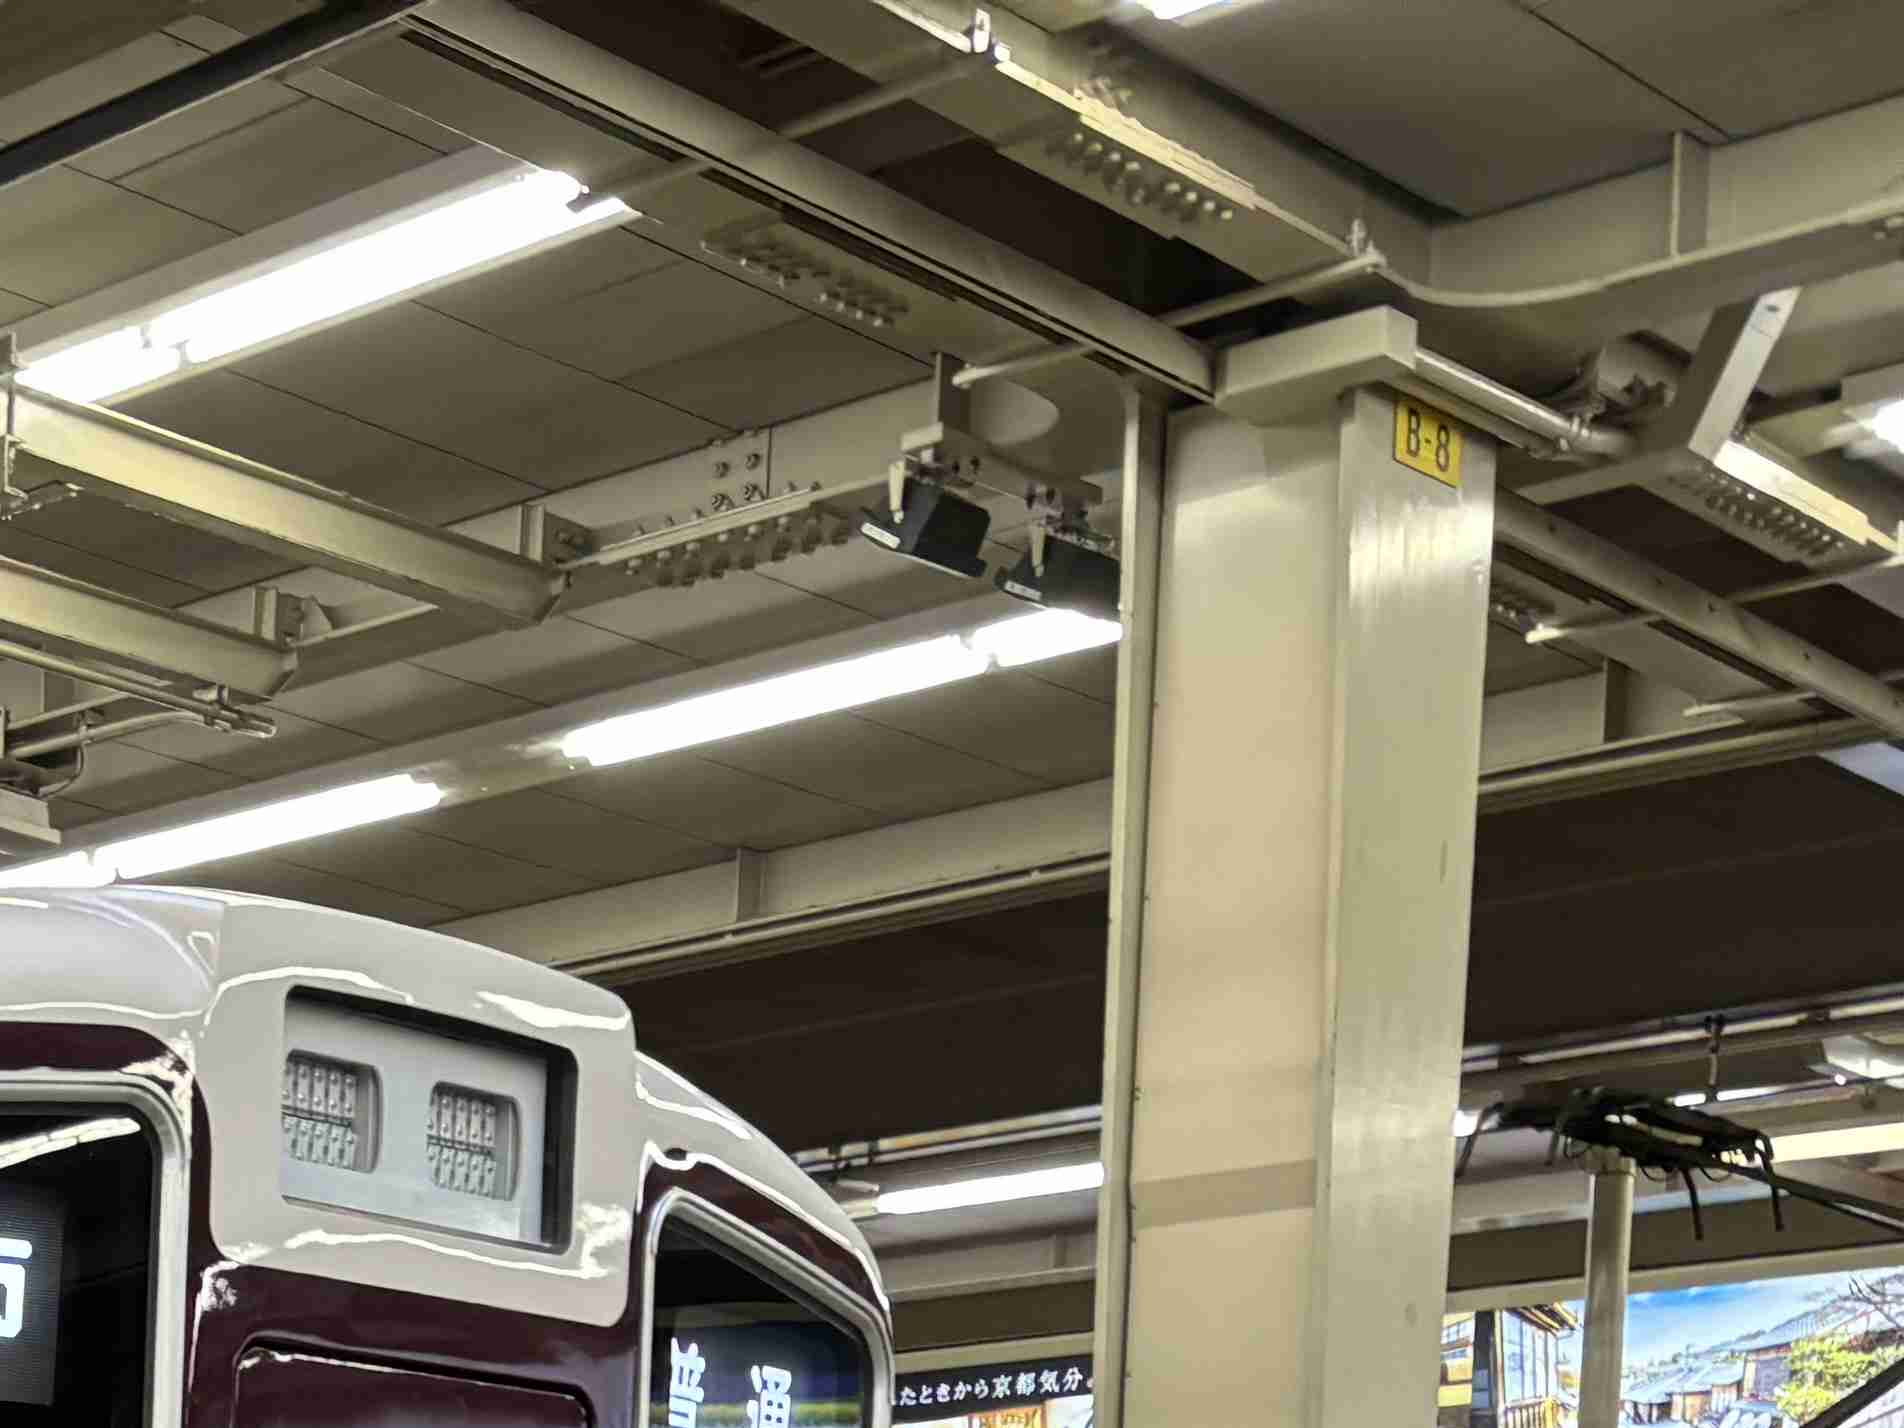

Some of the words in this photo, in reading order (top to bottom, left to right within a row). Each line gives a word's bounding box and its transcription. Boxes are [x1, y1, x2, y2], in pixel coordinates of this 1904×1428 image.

[1406, 407, 1450, 473] B-8
[891, 1366, 1094, 1406] たときから京都気分
